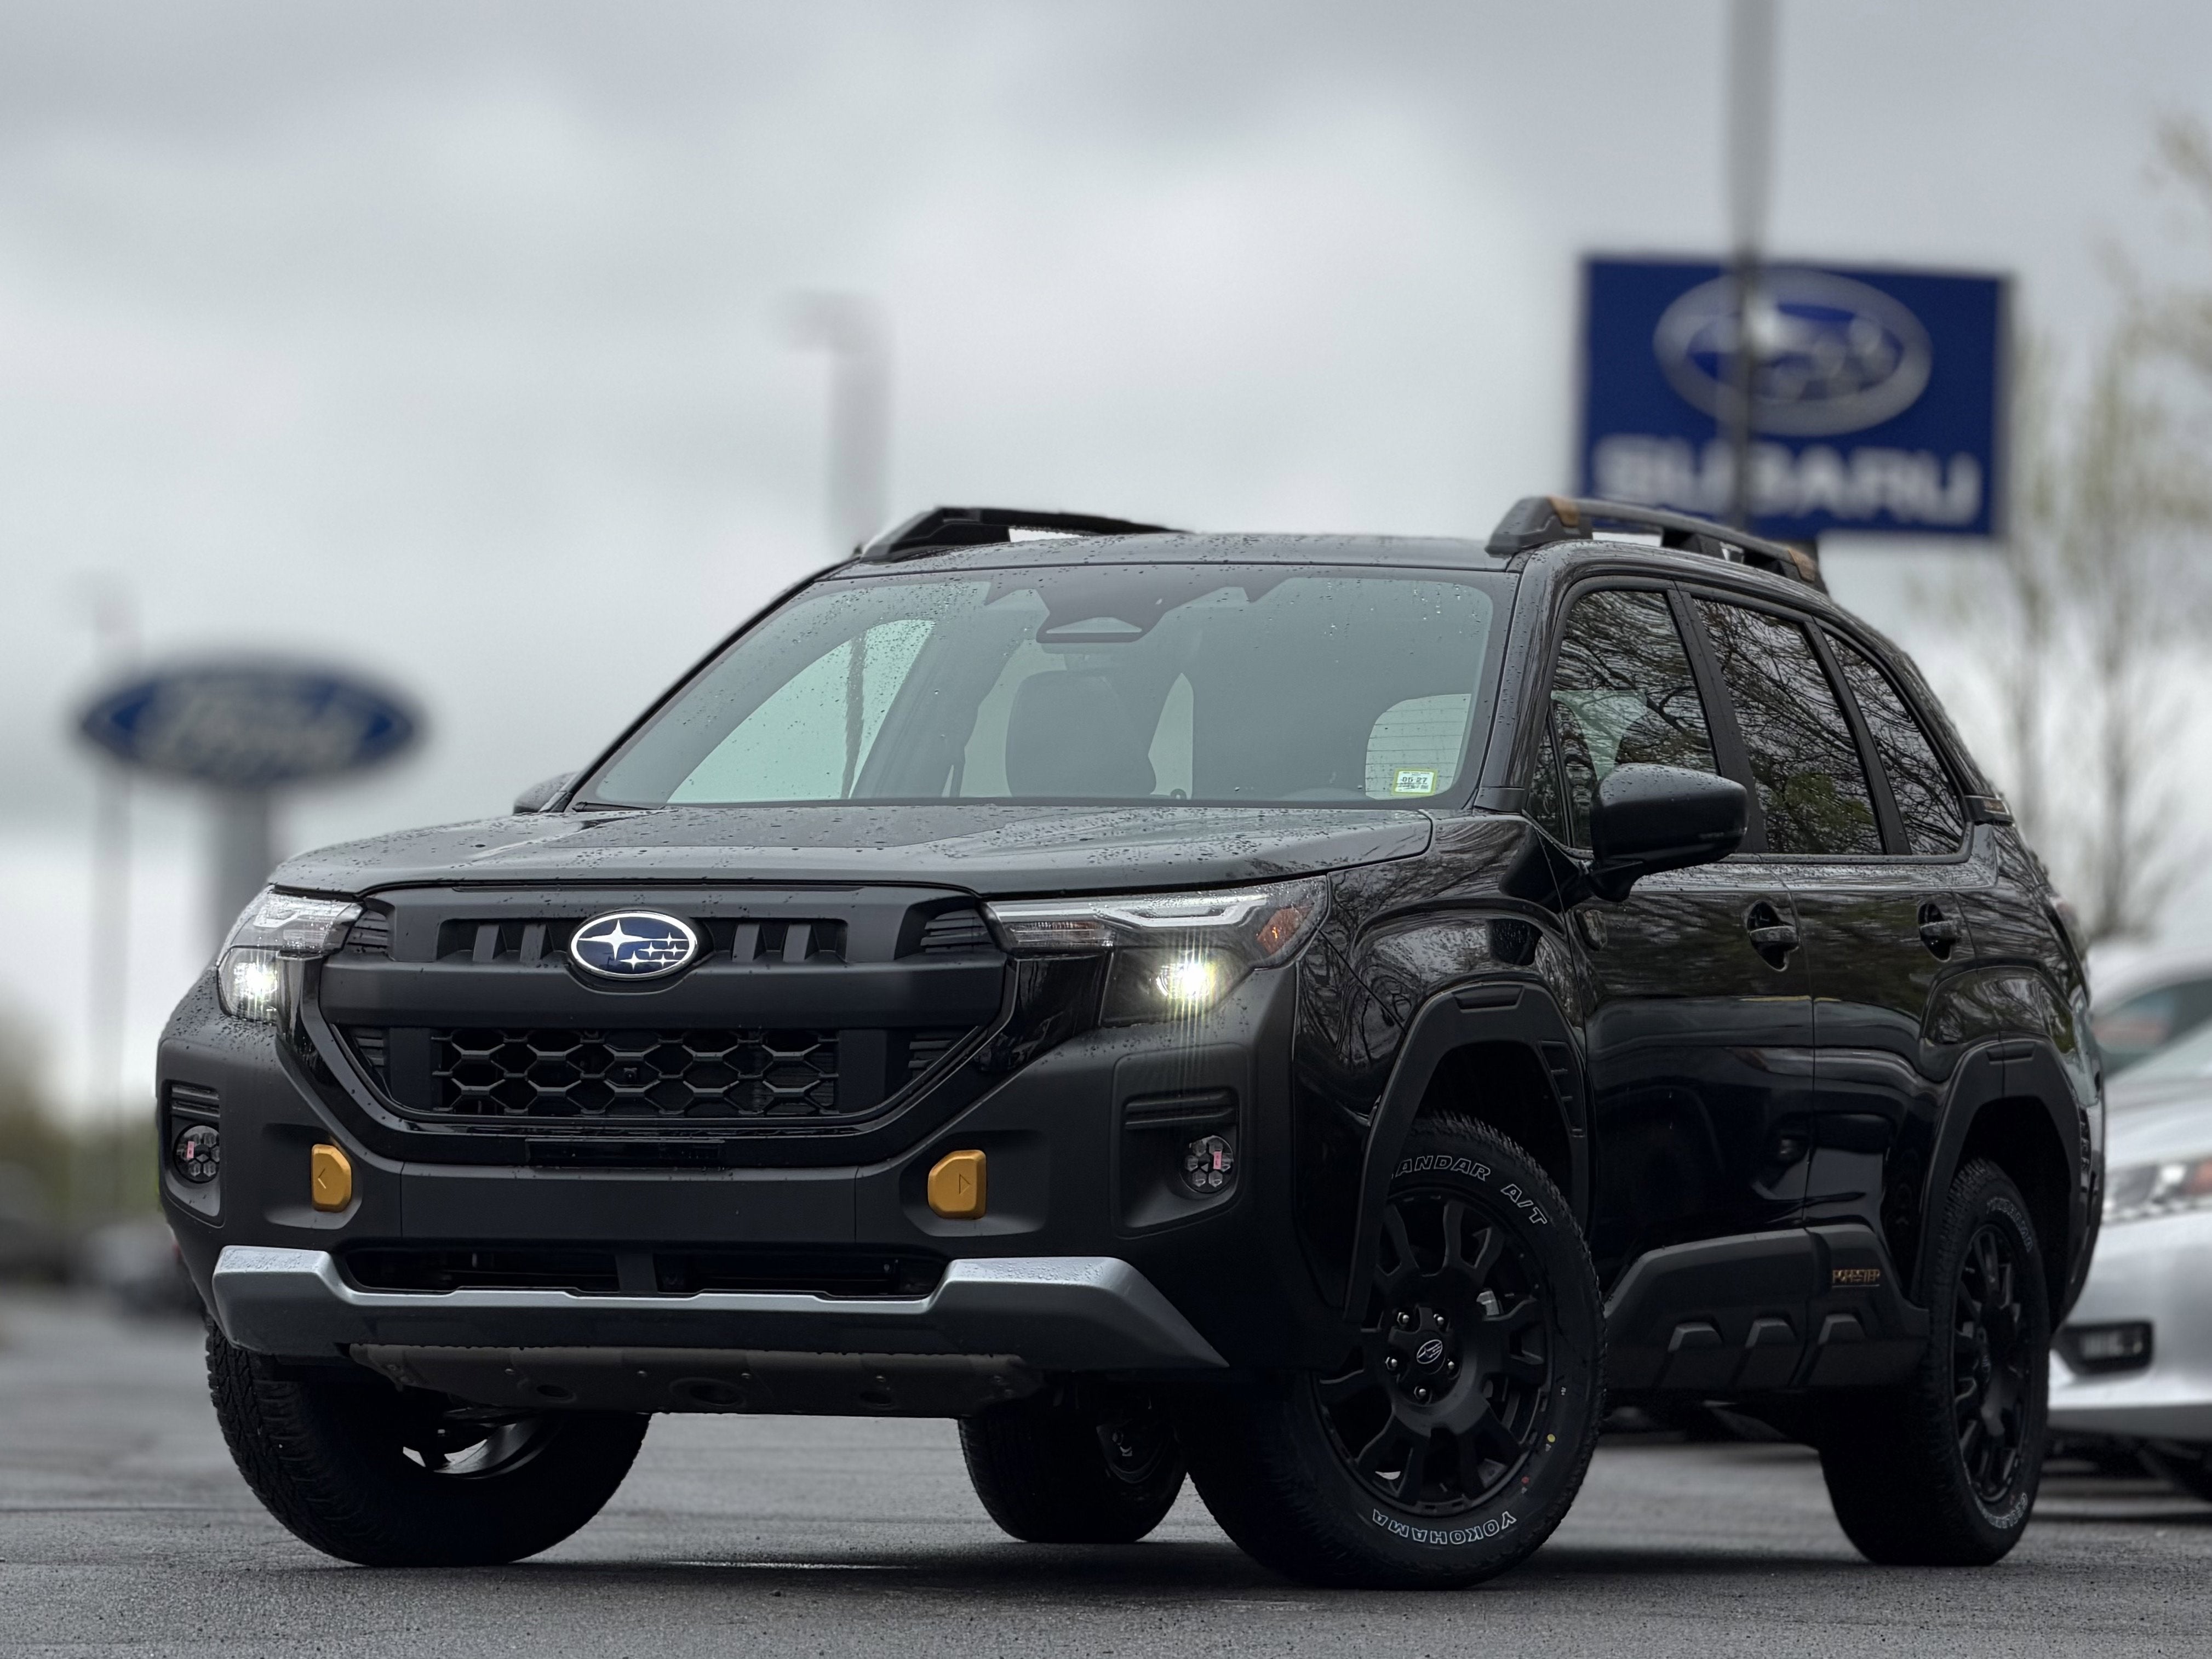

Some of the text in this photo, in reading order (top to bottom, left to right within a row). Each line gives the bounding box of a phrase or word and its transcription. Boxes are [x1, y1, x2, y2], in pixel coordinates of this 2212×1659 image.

[1392, 1155, 1548, 1225] ANDAR A/T
[1372, 1508, 1517, 1544] YOKOHAMA
